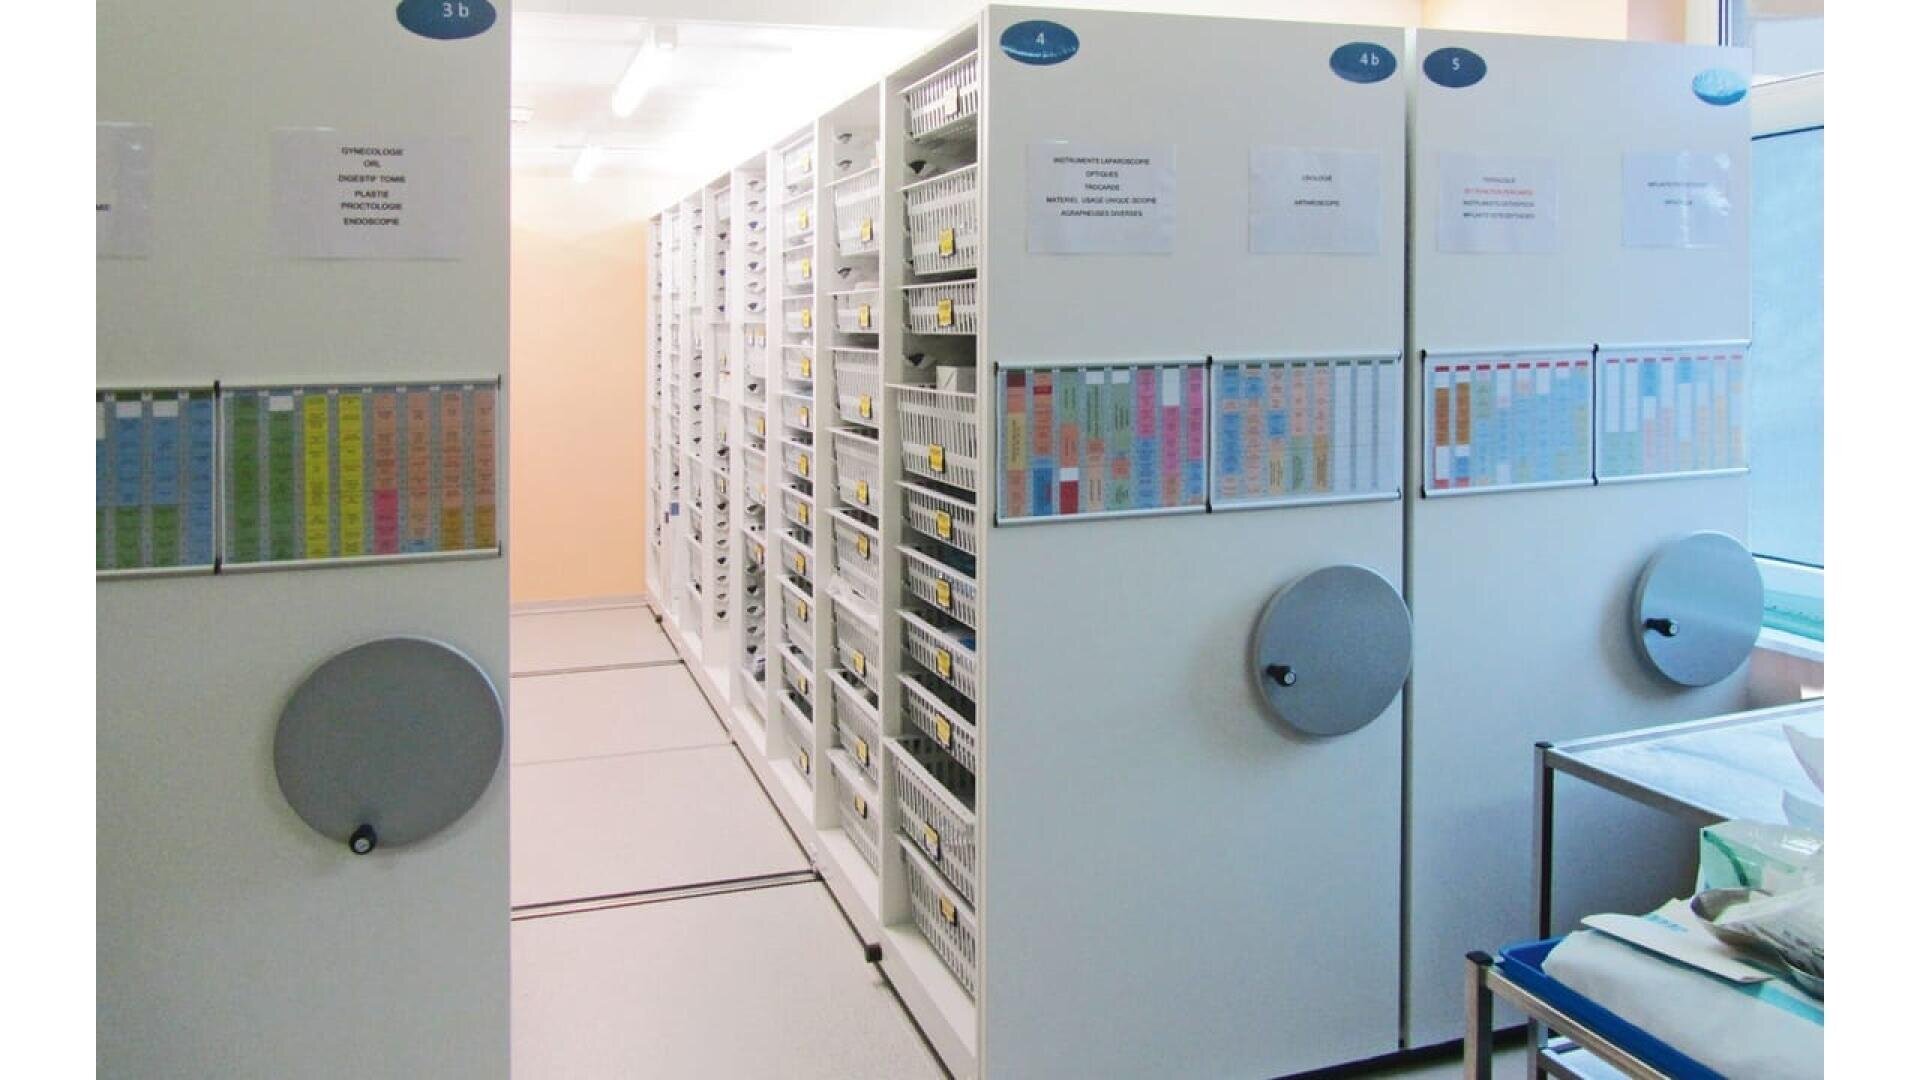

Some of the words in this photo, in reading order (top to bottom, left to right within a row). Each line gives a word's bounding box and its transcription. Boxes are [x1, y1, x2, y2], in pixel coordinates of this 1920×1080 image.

[443, 2, 453, 17] 3
[458, 1, 469, 17] b
[1035, 31, 1045, 45] 4
[1359, 52, 1369, 66] 4
[341, 146, 404, 156] GYNECOLOGIE
[338, 173, 377, 183] DIGESTIF
[340, 201, 403, 211] PROCTOLOGIE
[343, 217, 400, 226] ENDOSCOPIE
